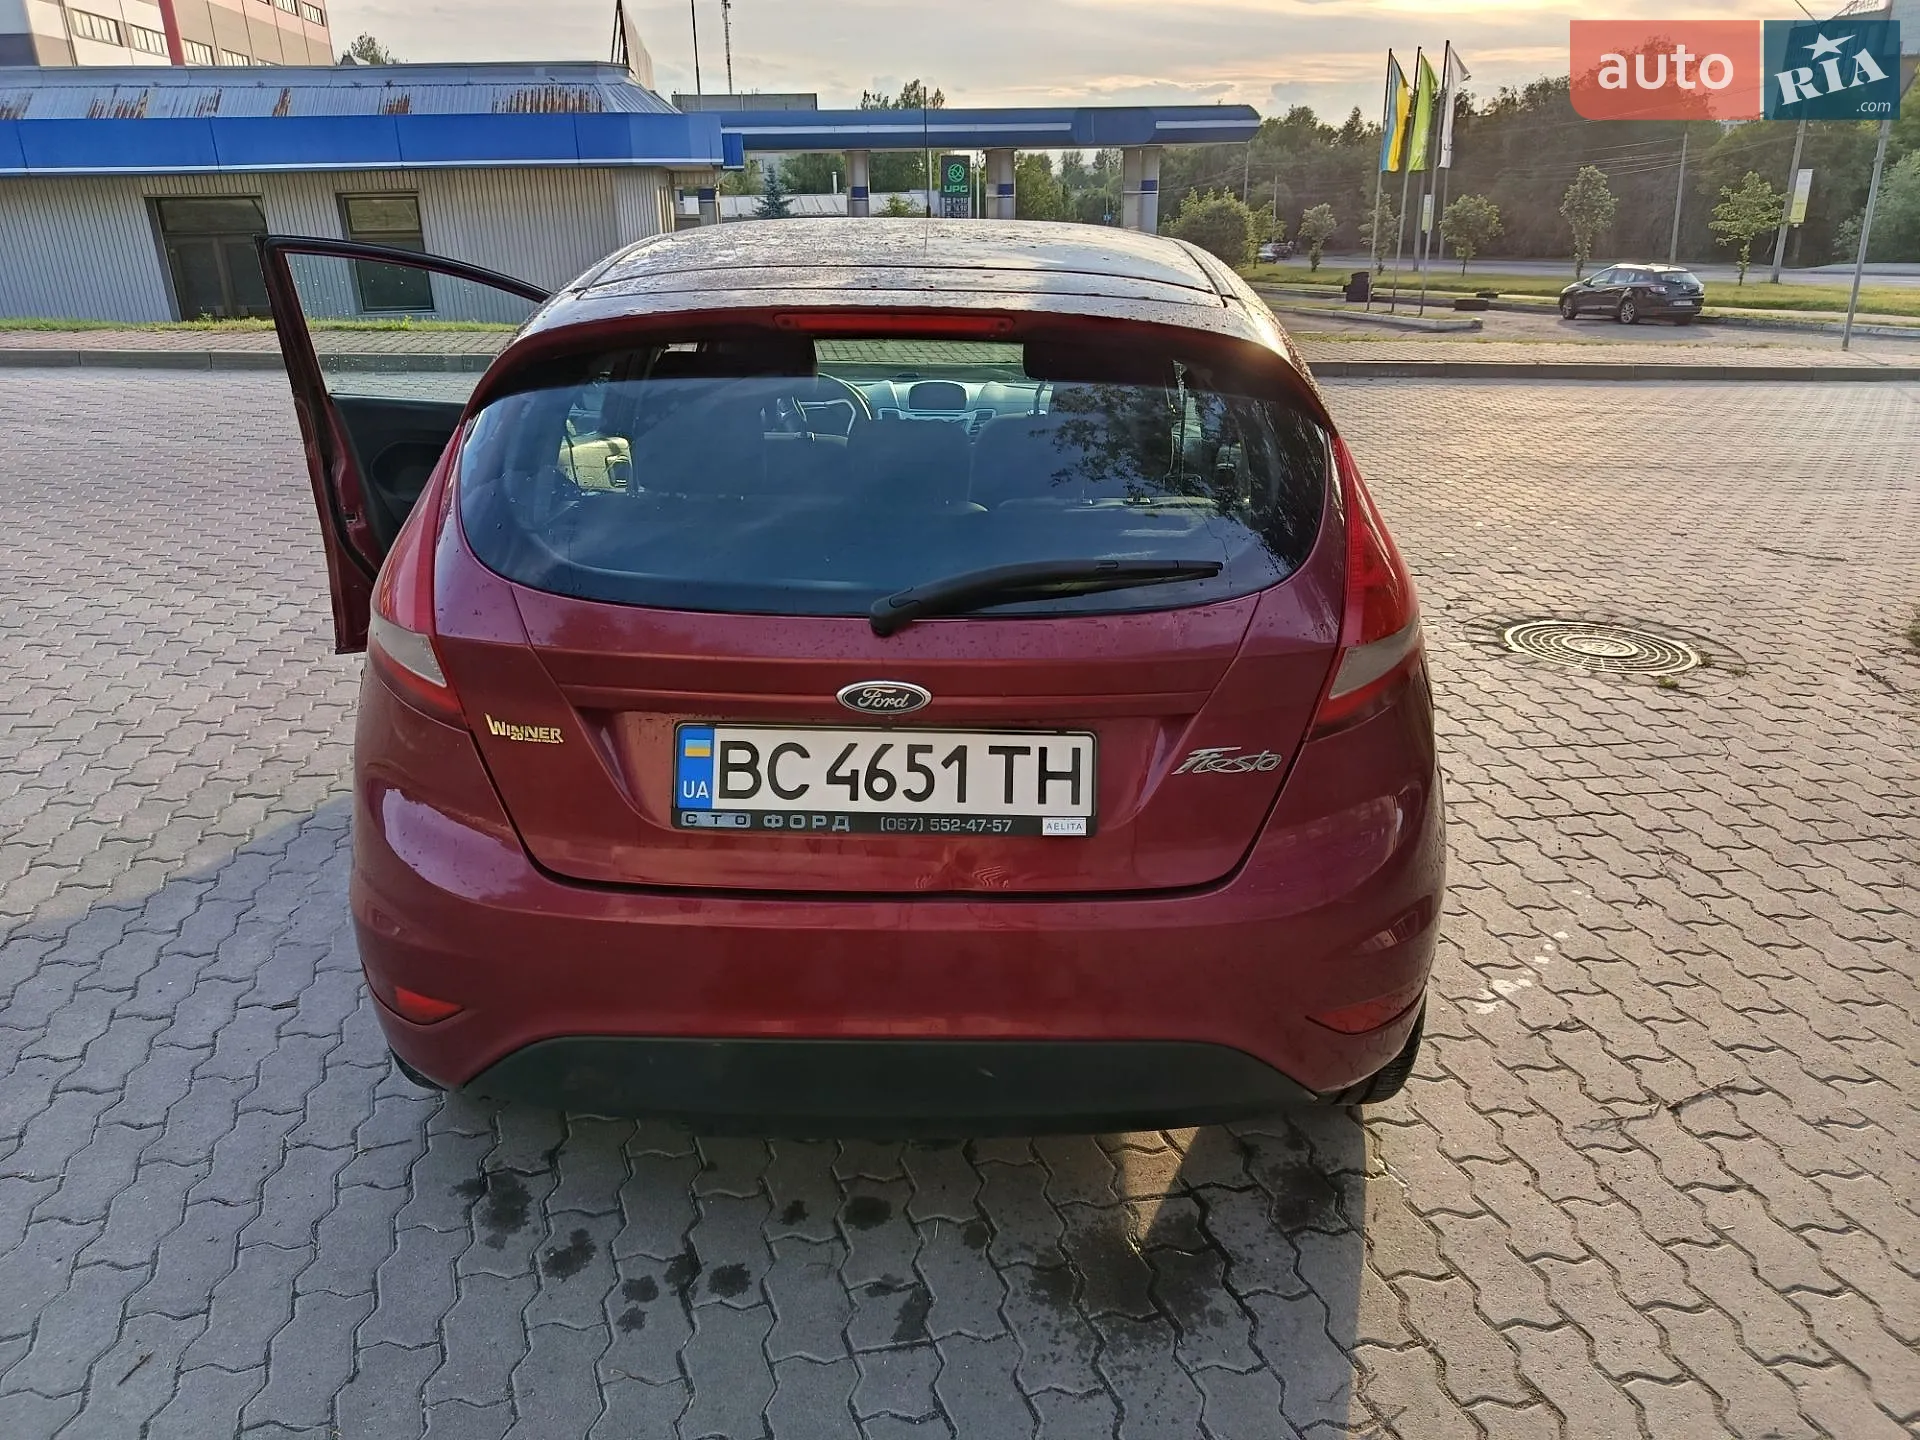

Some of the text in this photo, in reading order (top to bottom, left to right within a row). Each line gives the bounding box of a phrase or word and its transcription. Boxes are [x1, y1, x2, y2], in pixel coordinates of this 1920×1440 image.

[944, 185, 968, 193] UPG
[857, 687, 910, 708] Ford
[1171, 746, 1282, 775] Fiesta
[719, 741, 1081, 805] BC 4651 TH
[683, 781, 709, 799] UA
[763, 814, 850, 832] ФОРД
[930, 818, 1013, 833] 552-47-57
[1046, 823, 1084, 832] AELITA
